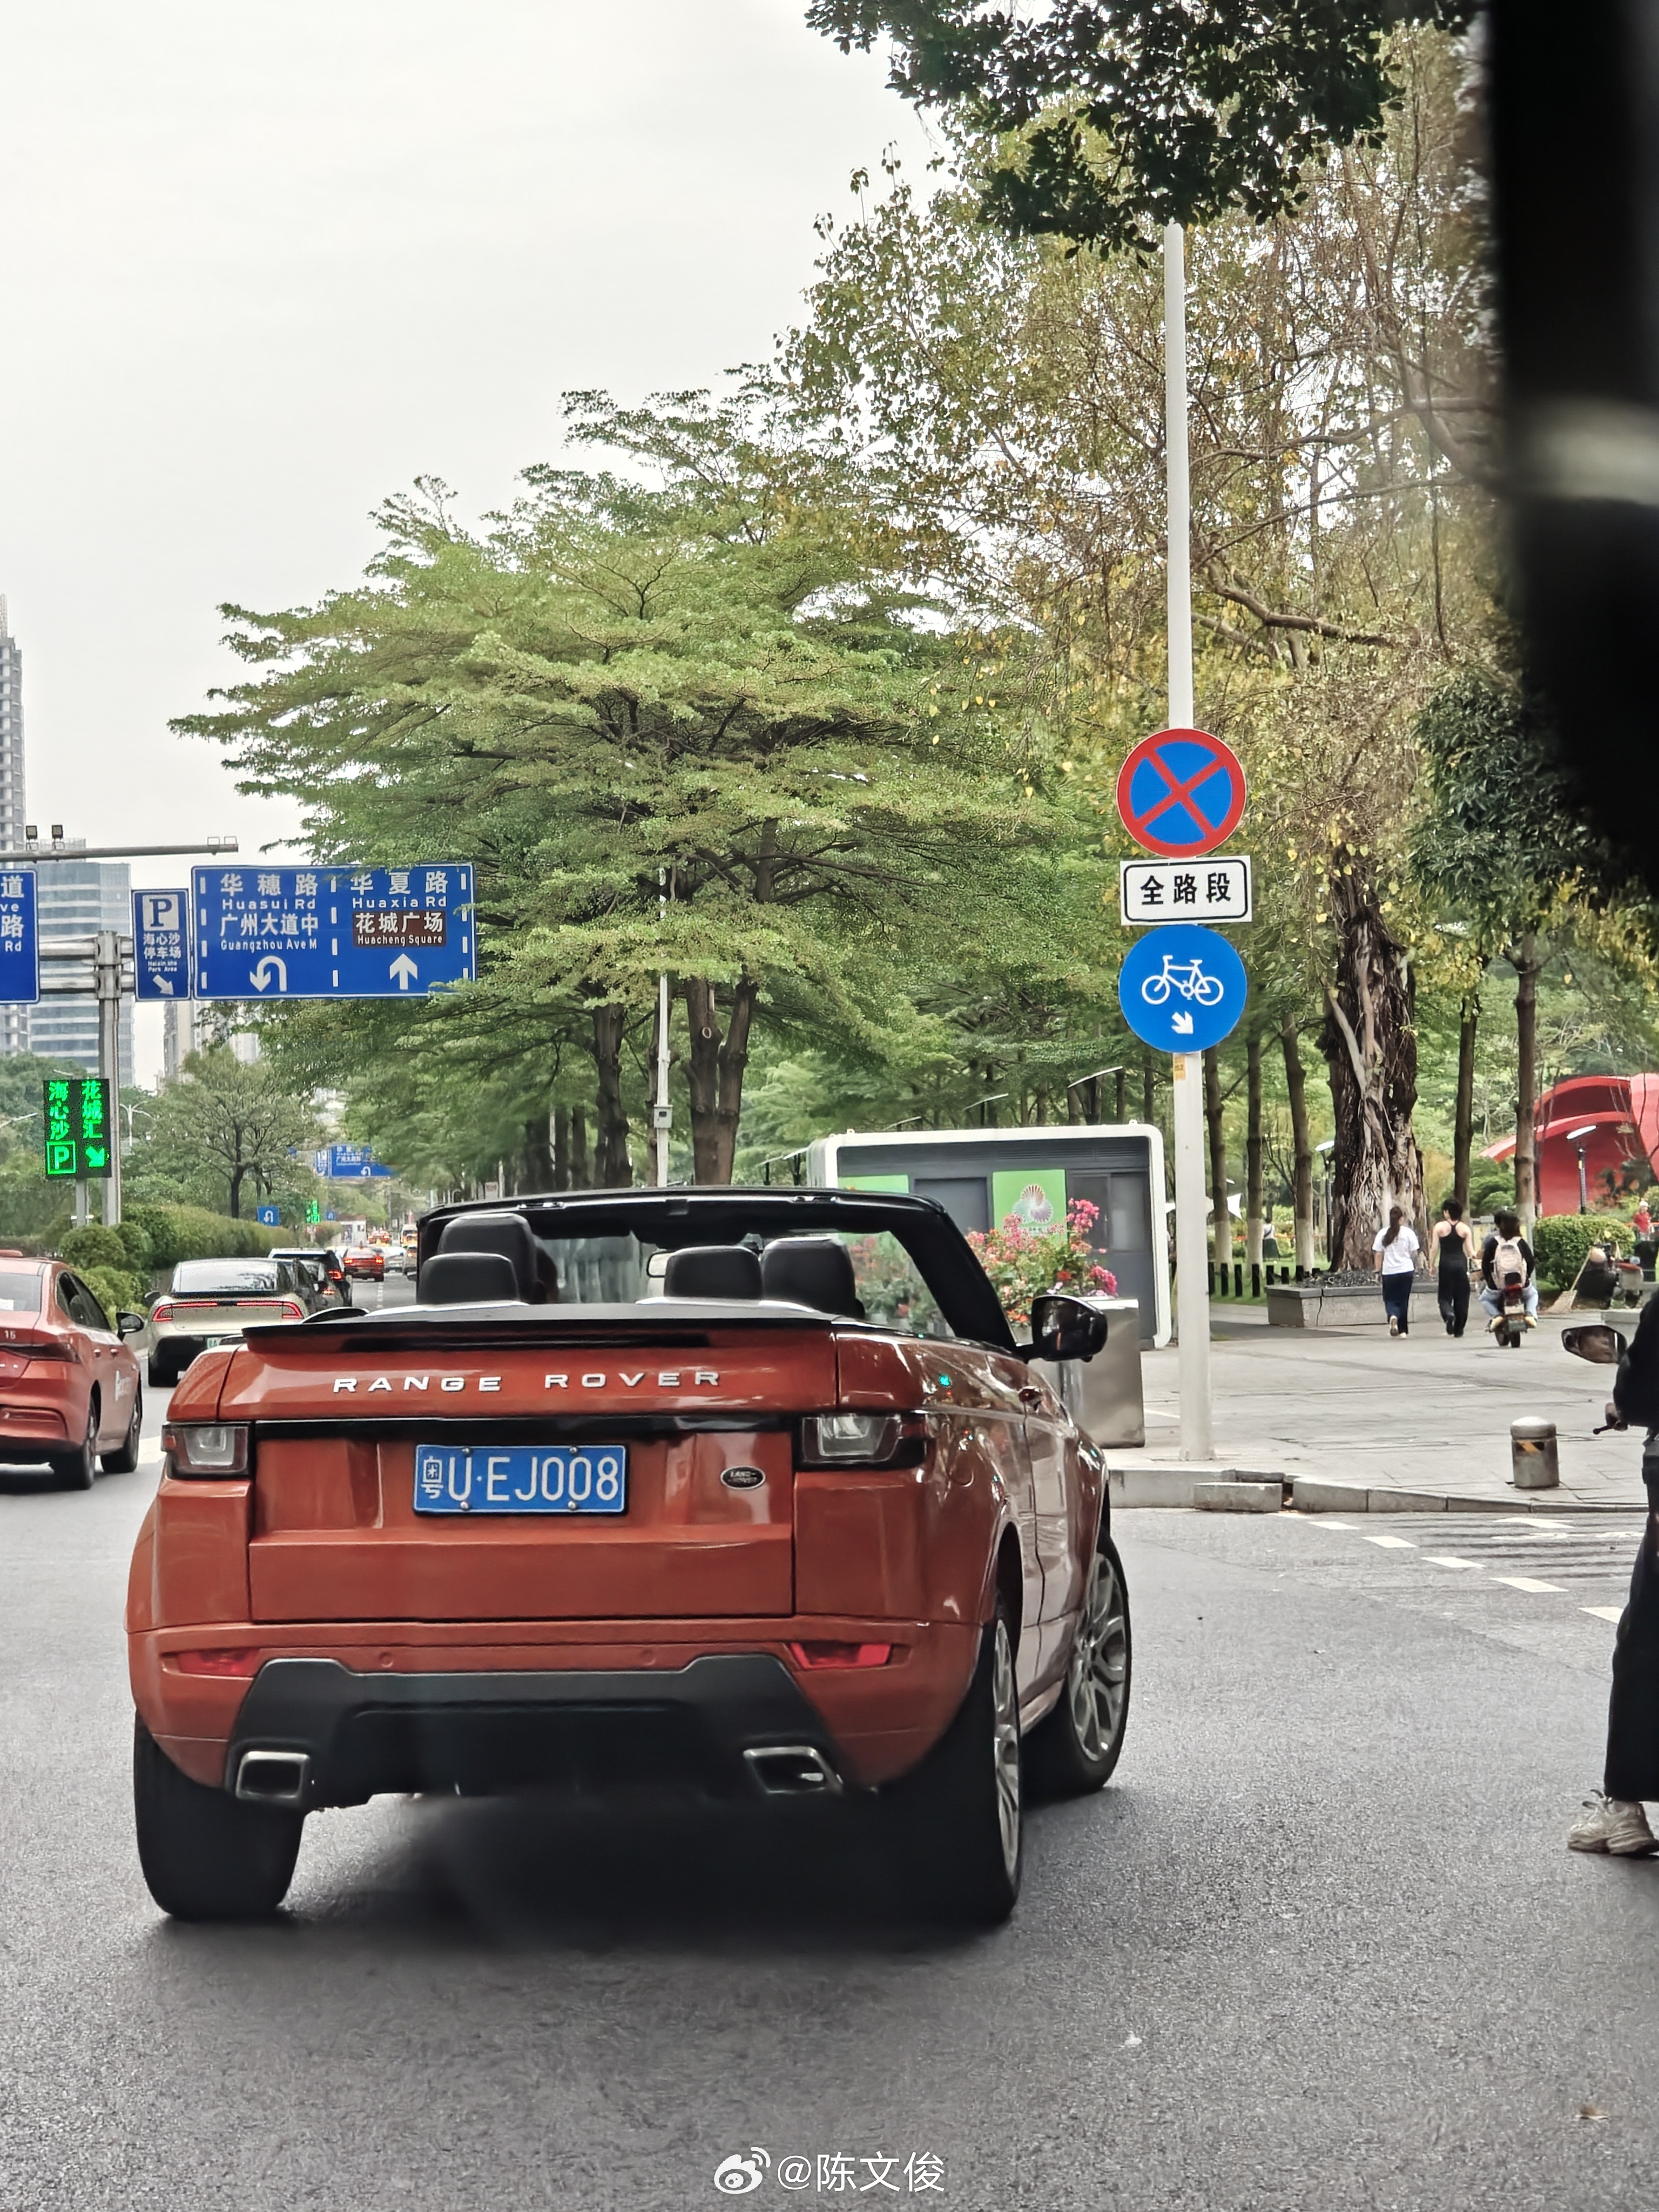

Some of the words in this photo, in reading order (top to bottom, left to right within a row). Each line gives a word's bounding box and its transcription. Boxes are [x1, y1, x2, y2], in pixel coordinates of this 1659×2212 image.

[1, 875, 24, 898] 道
[220, 873, 318, 896] 华穗路
[350, 871, 448, 895] 华夏路
[1141, 872, 1231, 906] 全路段
[150, 899, 172, 927] P
[222, 899, 287, 910] Huasui
[295, 898, 315, 909] Rd
[353, 897, 419, 908] Huaxia
[426, 896, 447, 907] Rd
[1, 915, 24, 938] 路
[220, 912, 319, 936] 广州大道中
[355, 912, 443, 934] 花城广场
[5, 941, 21, 952] Rd
[143, 932, 180, 946] 海心沙
[221, 939, 283, 953] Guangzhou
[287, 939, 306, 949] Ave
[309, 938, 317, 949] M
[358, 935, 405, 946] Huacheng
[408, 935, 442, 946] Square
[144, 946, 181, 960] 停车场
[49, 1082, 70, 1140] 海心沙
[82, 1081, 103, 1138] 花城汇
[55, 1146, 70, 1169] P
[332, 1376, 502, 1393] RANGE
[544, 1371, 720, 1388] ROVER
